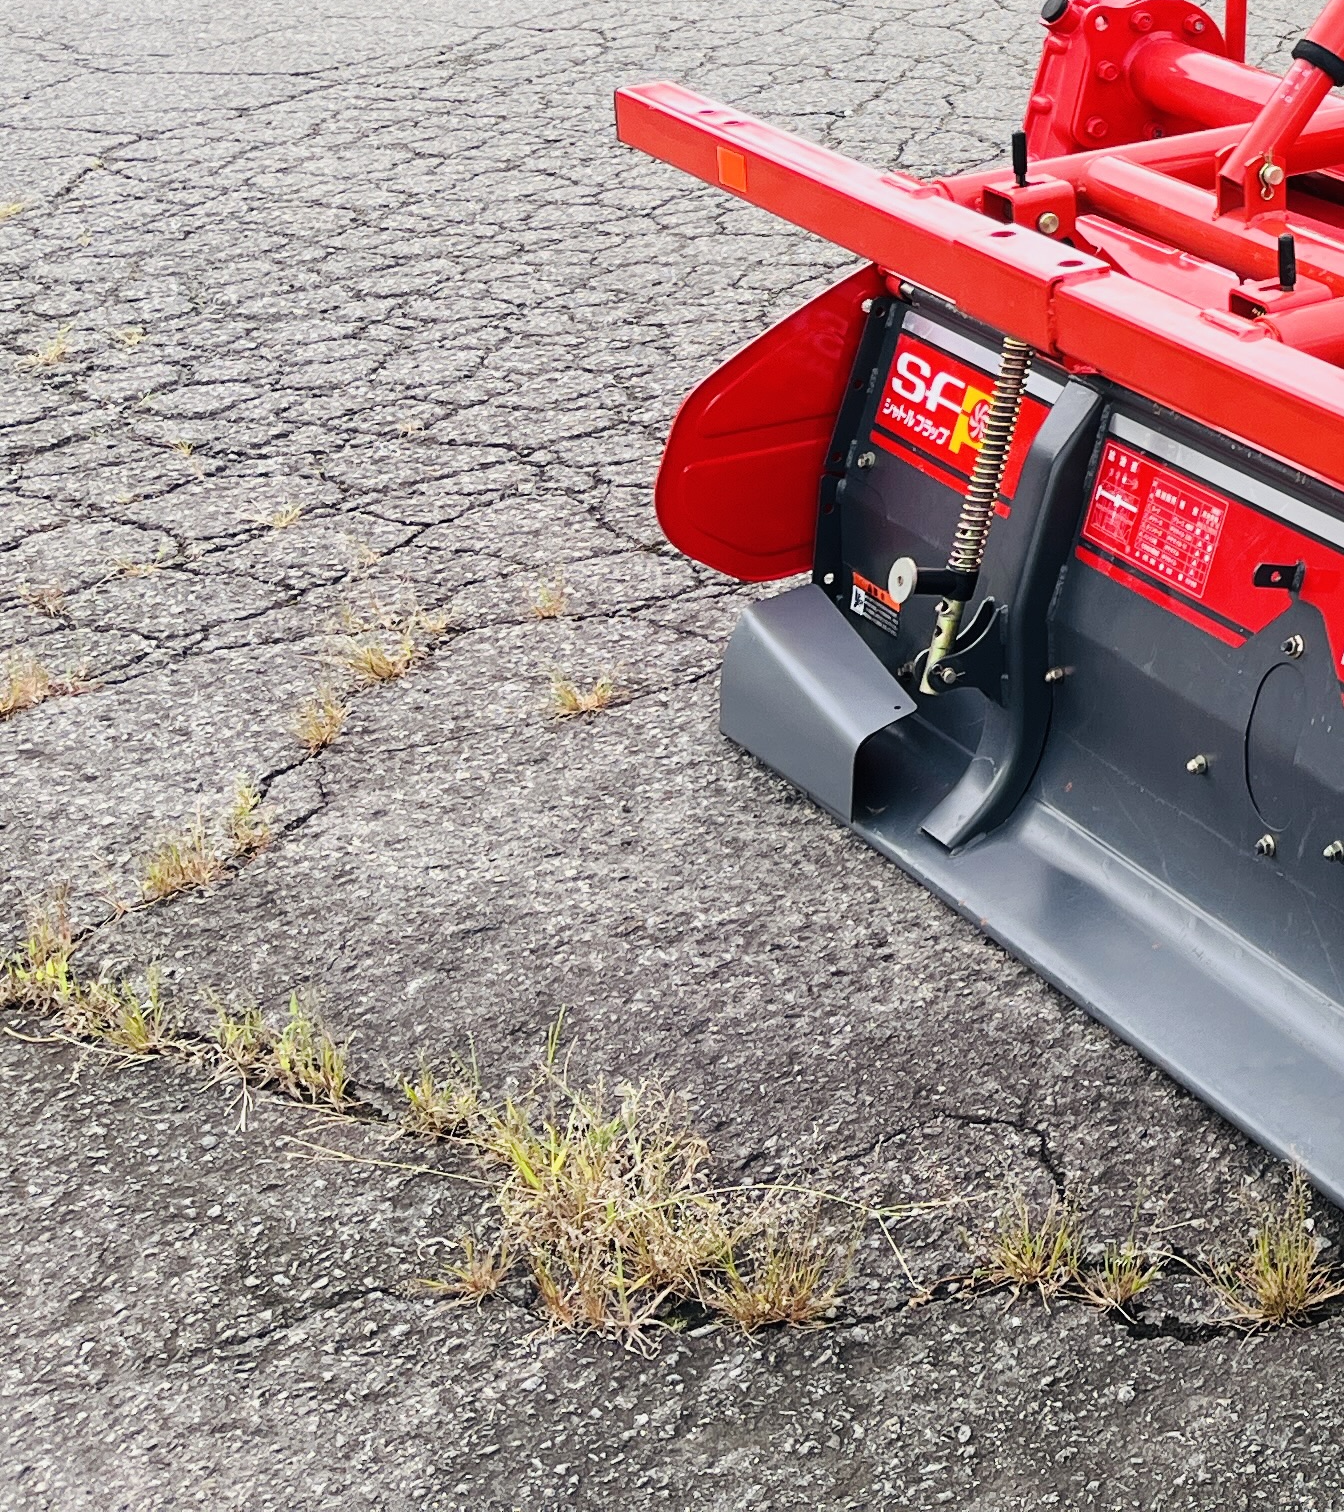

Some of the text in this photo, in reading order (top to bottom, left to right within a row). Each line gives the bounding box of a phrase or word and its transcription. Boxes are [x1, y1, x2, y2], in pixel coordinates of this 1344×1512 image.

[882, 397, 951, 446] シャトルフラップ
